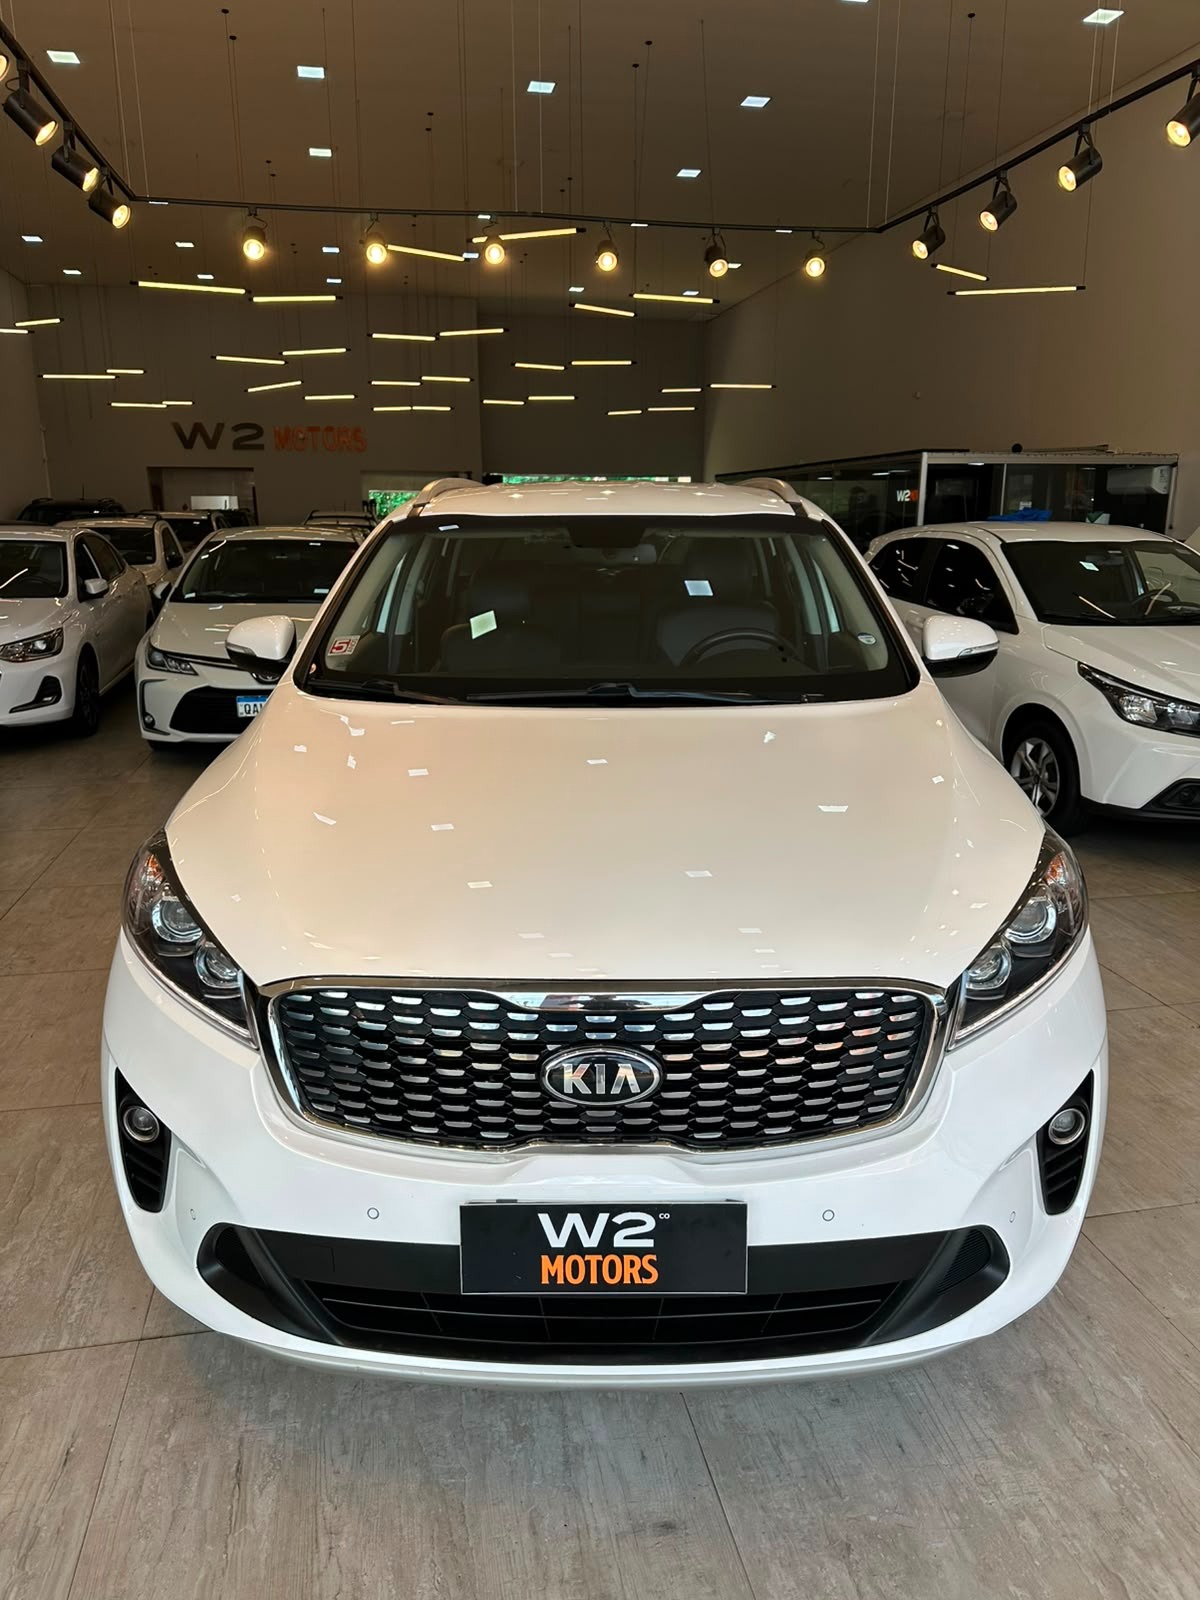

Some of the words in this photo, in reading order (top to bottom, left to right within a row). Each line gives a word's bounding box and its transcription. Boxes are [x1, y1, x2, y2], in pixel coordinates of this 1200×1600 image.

[171, 421, 265, 451] W2
[273, 425, 368, 453] MOTORS
[244, 702, 264, 715] QA
[562, 1063, 641, 1095] KIA
[537, 1211, 657, 1248] W2
[540, 1254, 659, 1285] MOTORS
